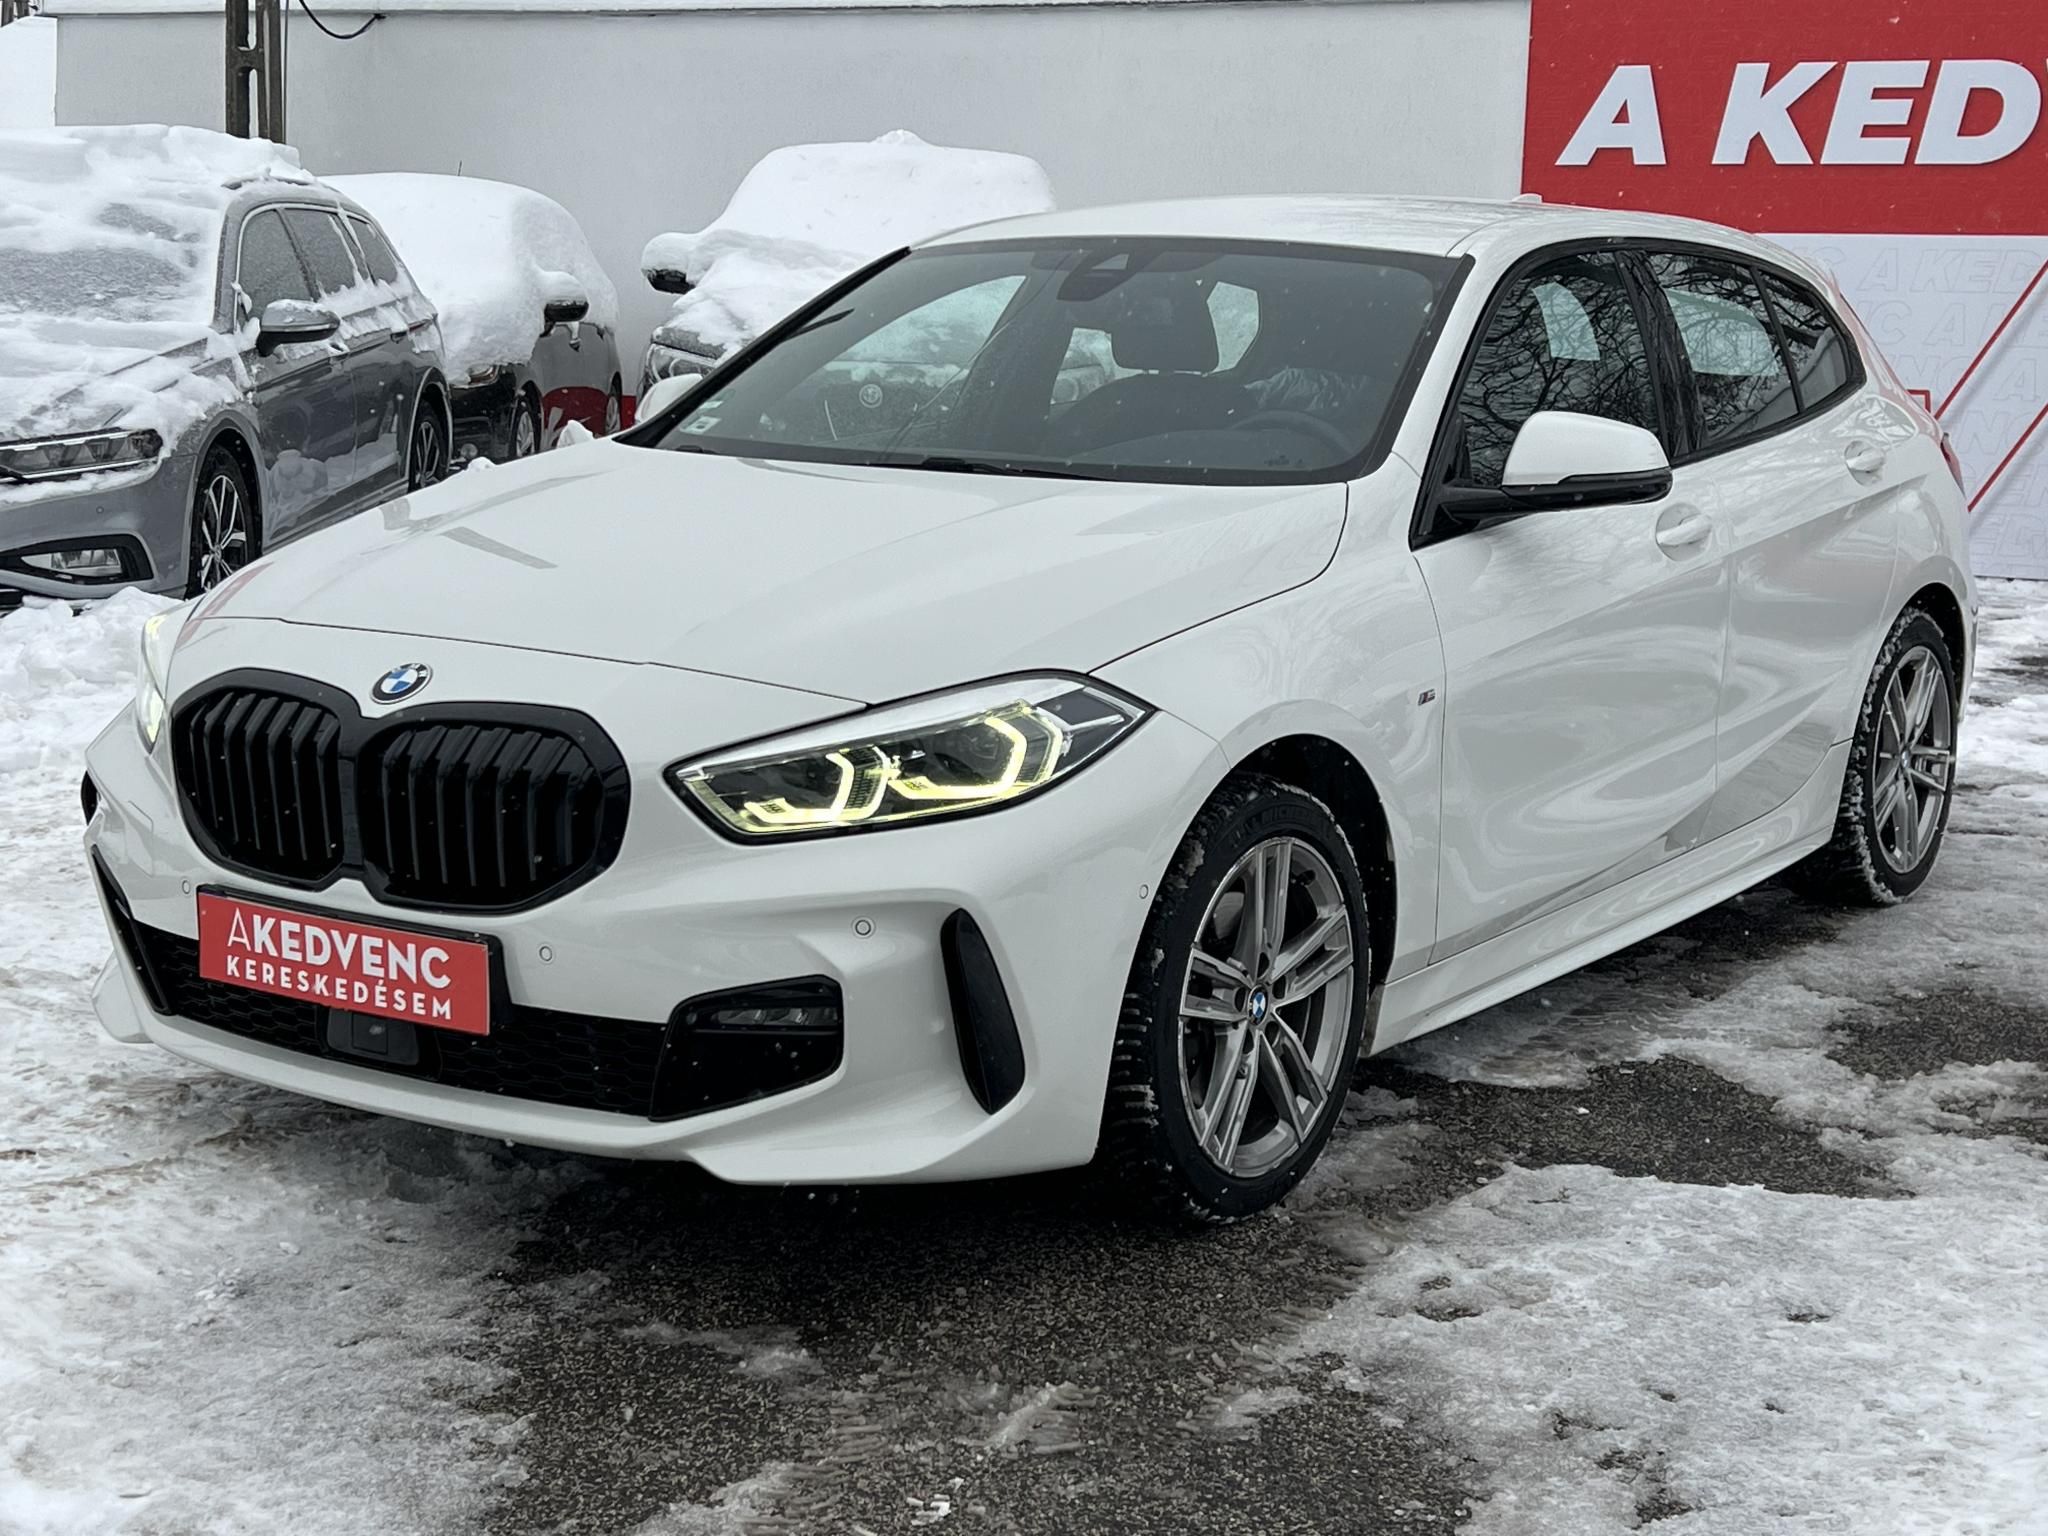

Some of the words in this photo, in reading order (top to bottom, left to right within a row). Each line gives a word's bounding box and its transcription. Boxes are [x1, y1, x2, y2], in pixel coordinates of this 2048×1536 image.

[1555, 64, 1667, 167] A
[1711, 58, 2048, 167] KED
[226, 954, 452, 1020] KERESKEDÉSEM
